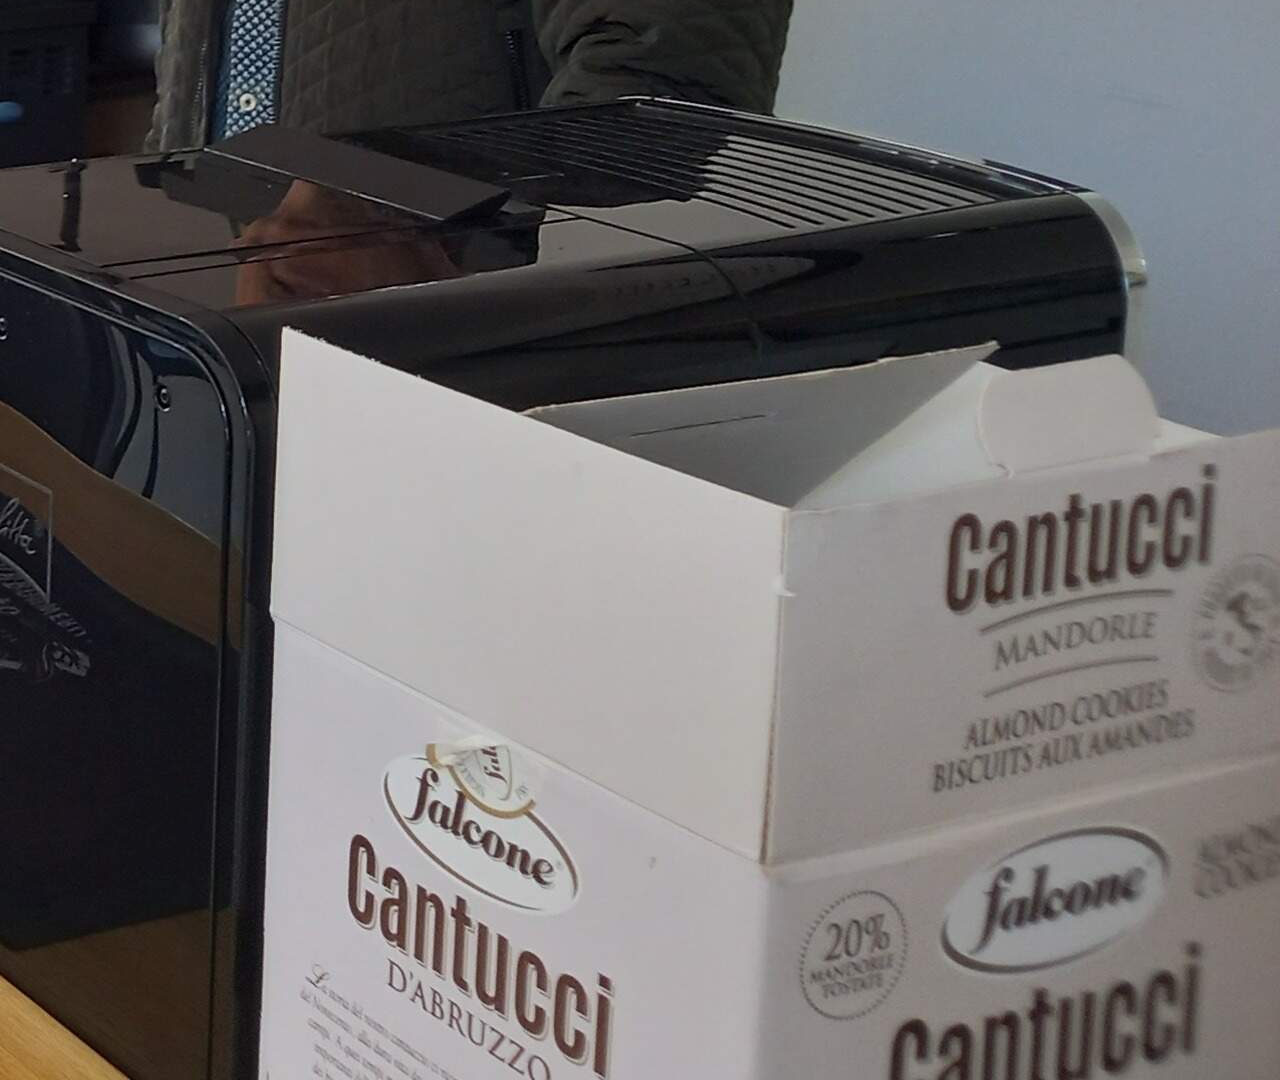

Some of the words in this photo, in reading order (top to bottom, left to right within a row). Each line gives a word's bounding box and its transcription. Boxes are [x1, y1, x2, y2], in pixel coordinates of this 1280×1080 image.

[945, 462, 1218, 613] Cantucci
[994, 612, 1158, 671] MANDORLE
[932, 743, 1034, 793] BISCUITS
[1039, 732, 1084, 769] AUX
[1086, 707, 1196, 758] AMANDES
[963, 701, 1066, 750] ALMOND
[1071, 678, 1169, 725] COOKIES
[402, 767, 556, 887] falcone
[347, 833, 615, 1079] Cantucci
[824, 913, 891, 961] 20%
[970, 864, 1147, 954] falcone
[386, 957, 552, 1080] D'ABRUZZO
[890, 940, 1205, 1080] Cantucci
